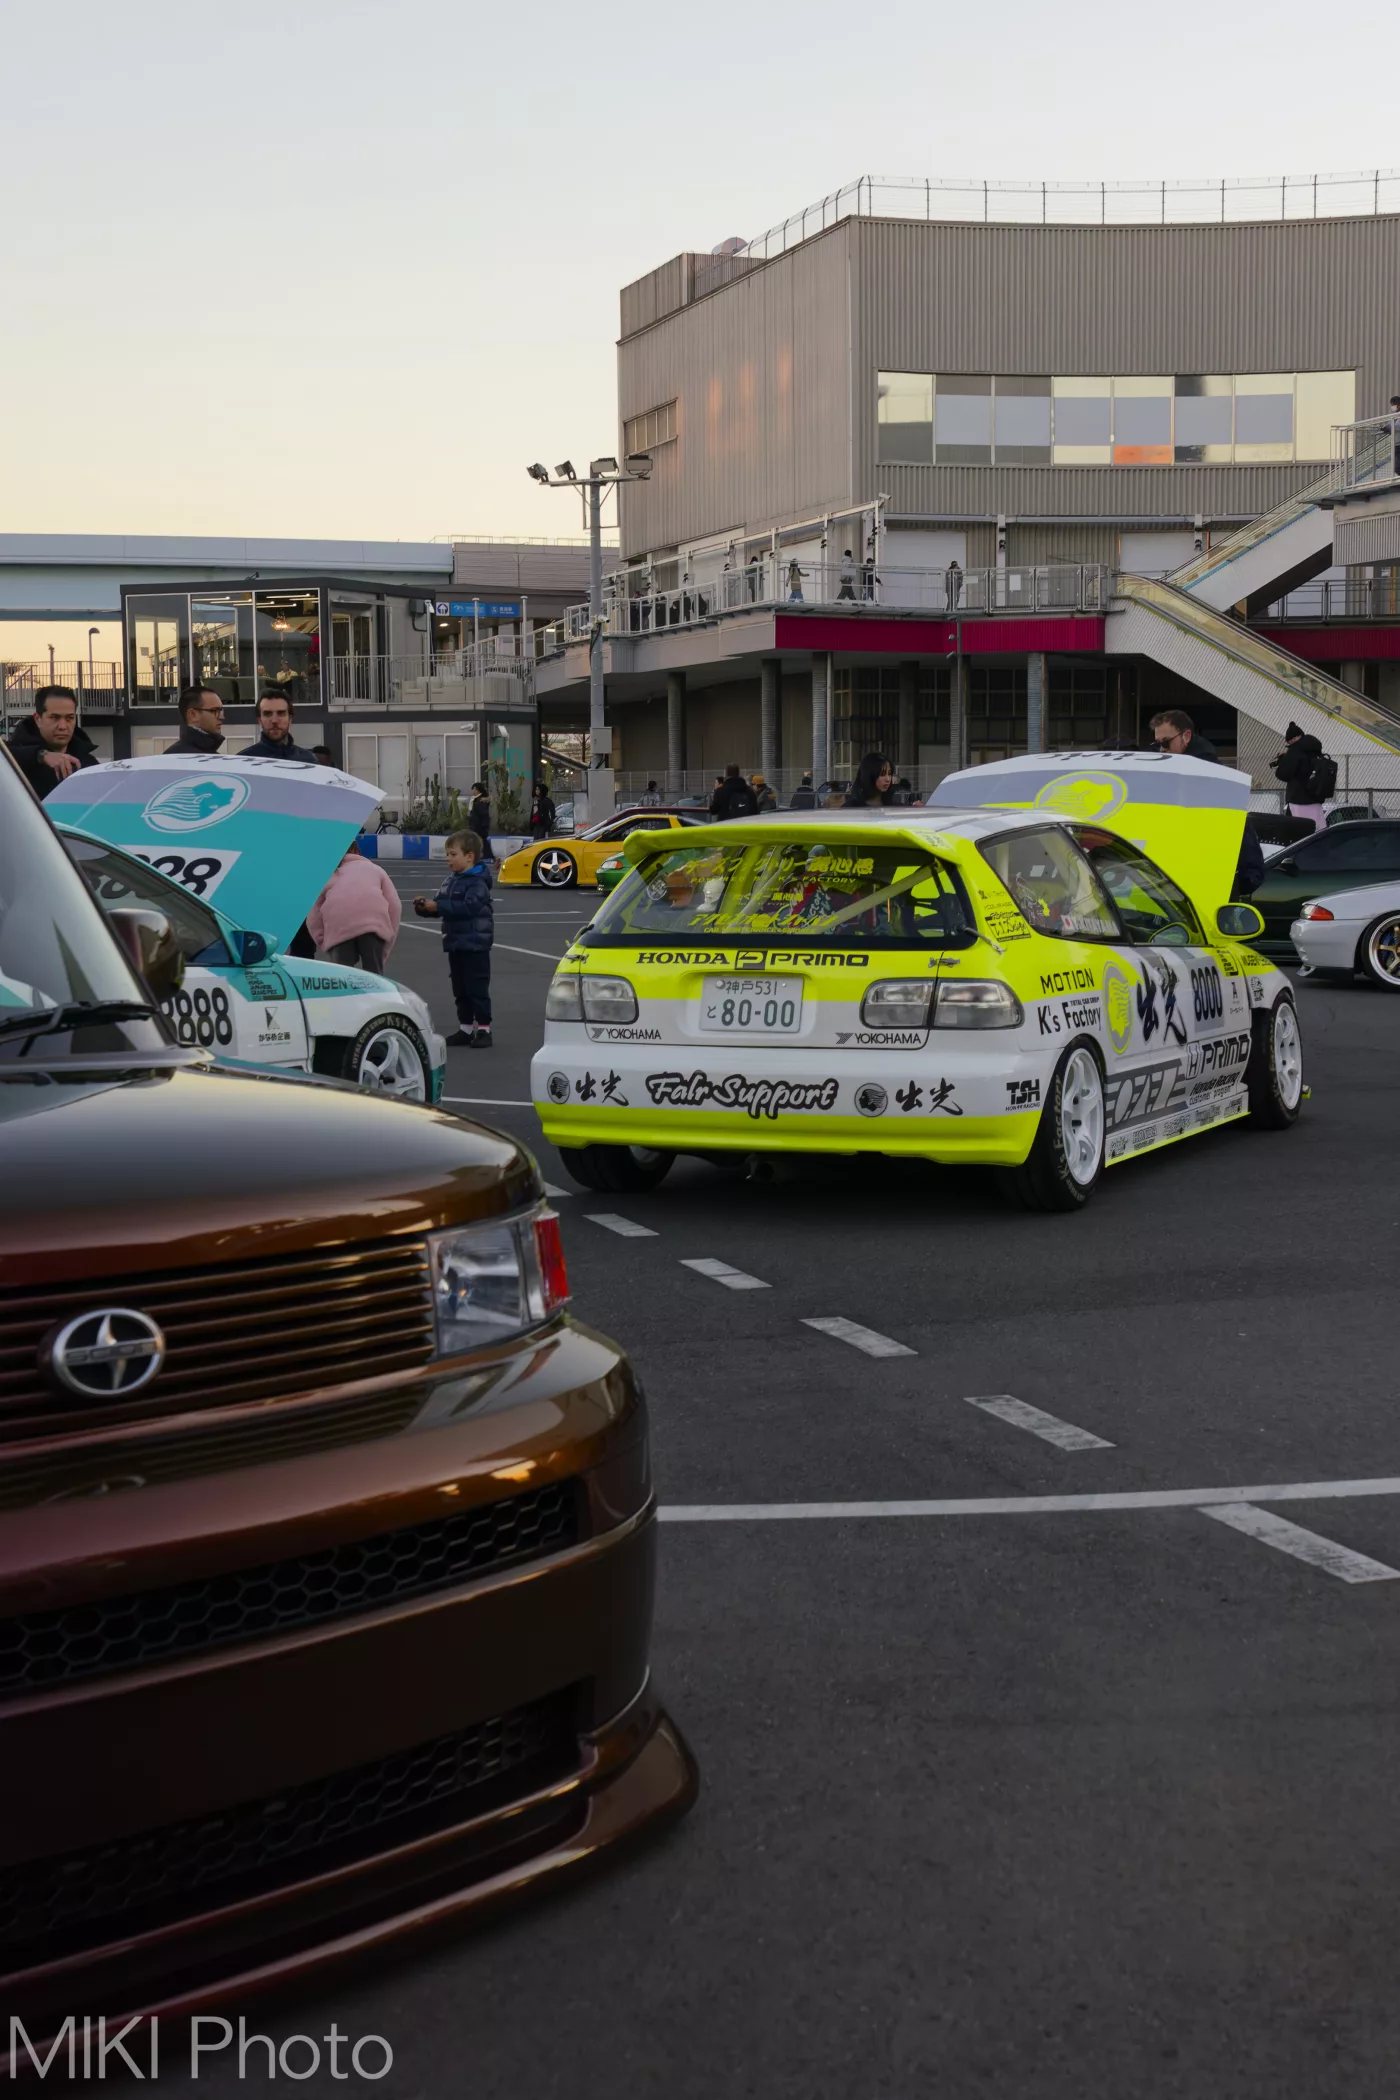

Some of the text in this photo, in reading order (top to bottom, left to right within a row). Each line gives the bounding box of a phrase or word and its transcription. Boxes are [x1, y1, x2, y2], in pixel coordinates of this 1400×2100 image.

[802, 876, 857, 884] FACTORY
[636, 951, 731, 966] HONDA
[770, 952, 870, 967] PRIMO
[302, 977, 348, 991] MUGEN
[1040, 968, 1095, 994] MOTION
[1190, 965, 1223, 1022] 8000
[706, 999, 796, 1028] と 80-00
[1037, 1002, 1102, 1036] K's Factory
[605, 1028, 662, 1041] YOKOHAMA
[855, 1032, 922, 1045] YOKOHAMA
[1201, 1033, 1251, 1074] PRIMO
[575, 1068, 630, 1107] 出光
[711, 1074, 839, 1120] Support
[895, 1077, 965, 1116] 出光
[1006, 1078, 1040, 1106] TSH
